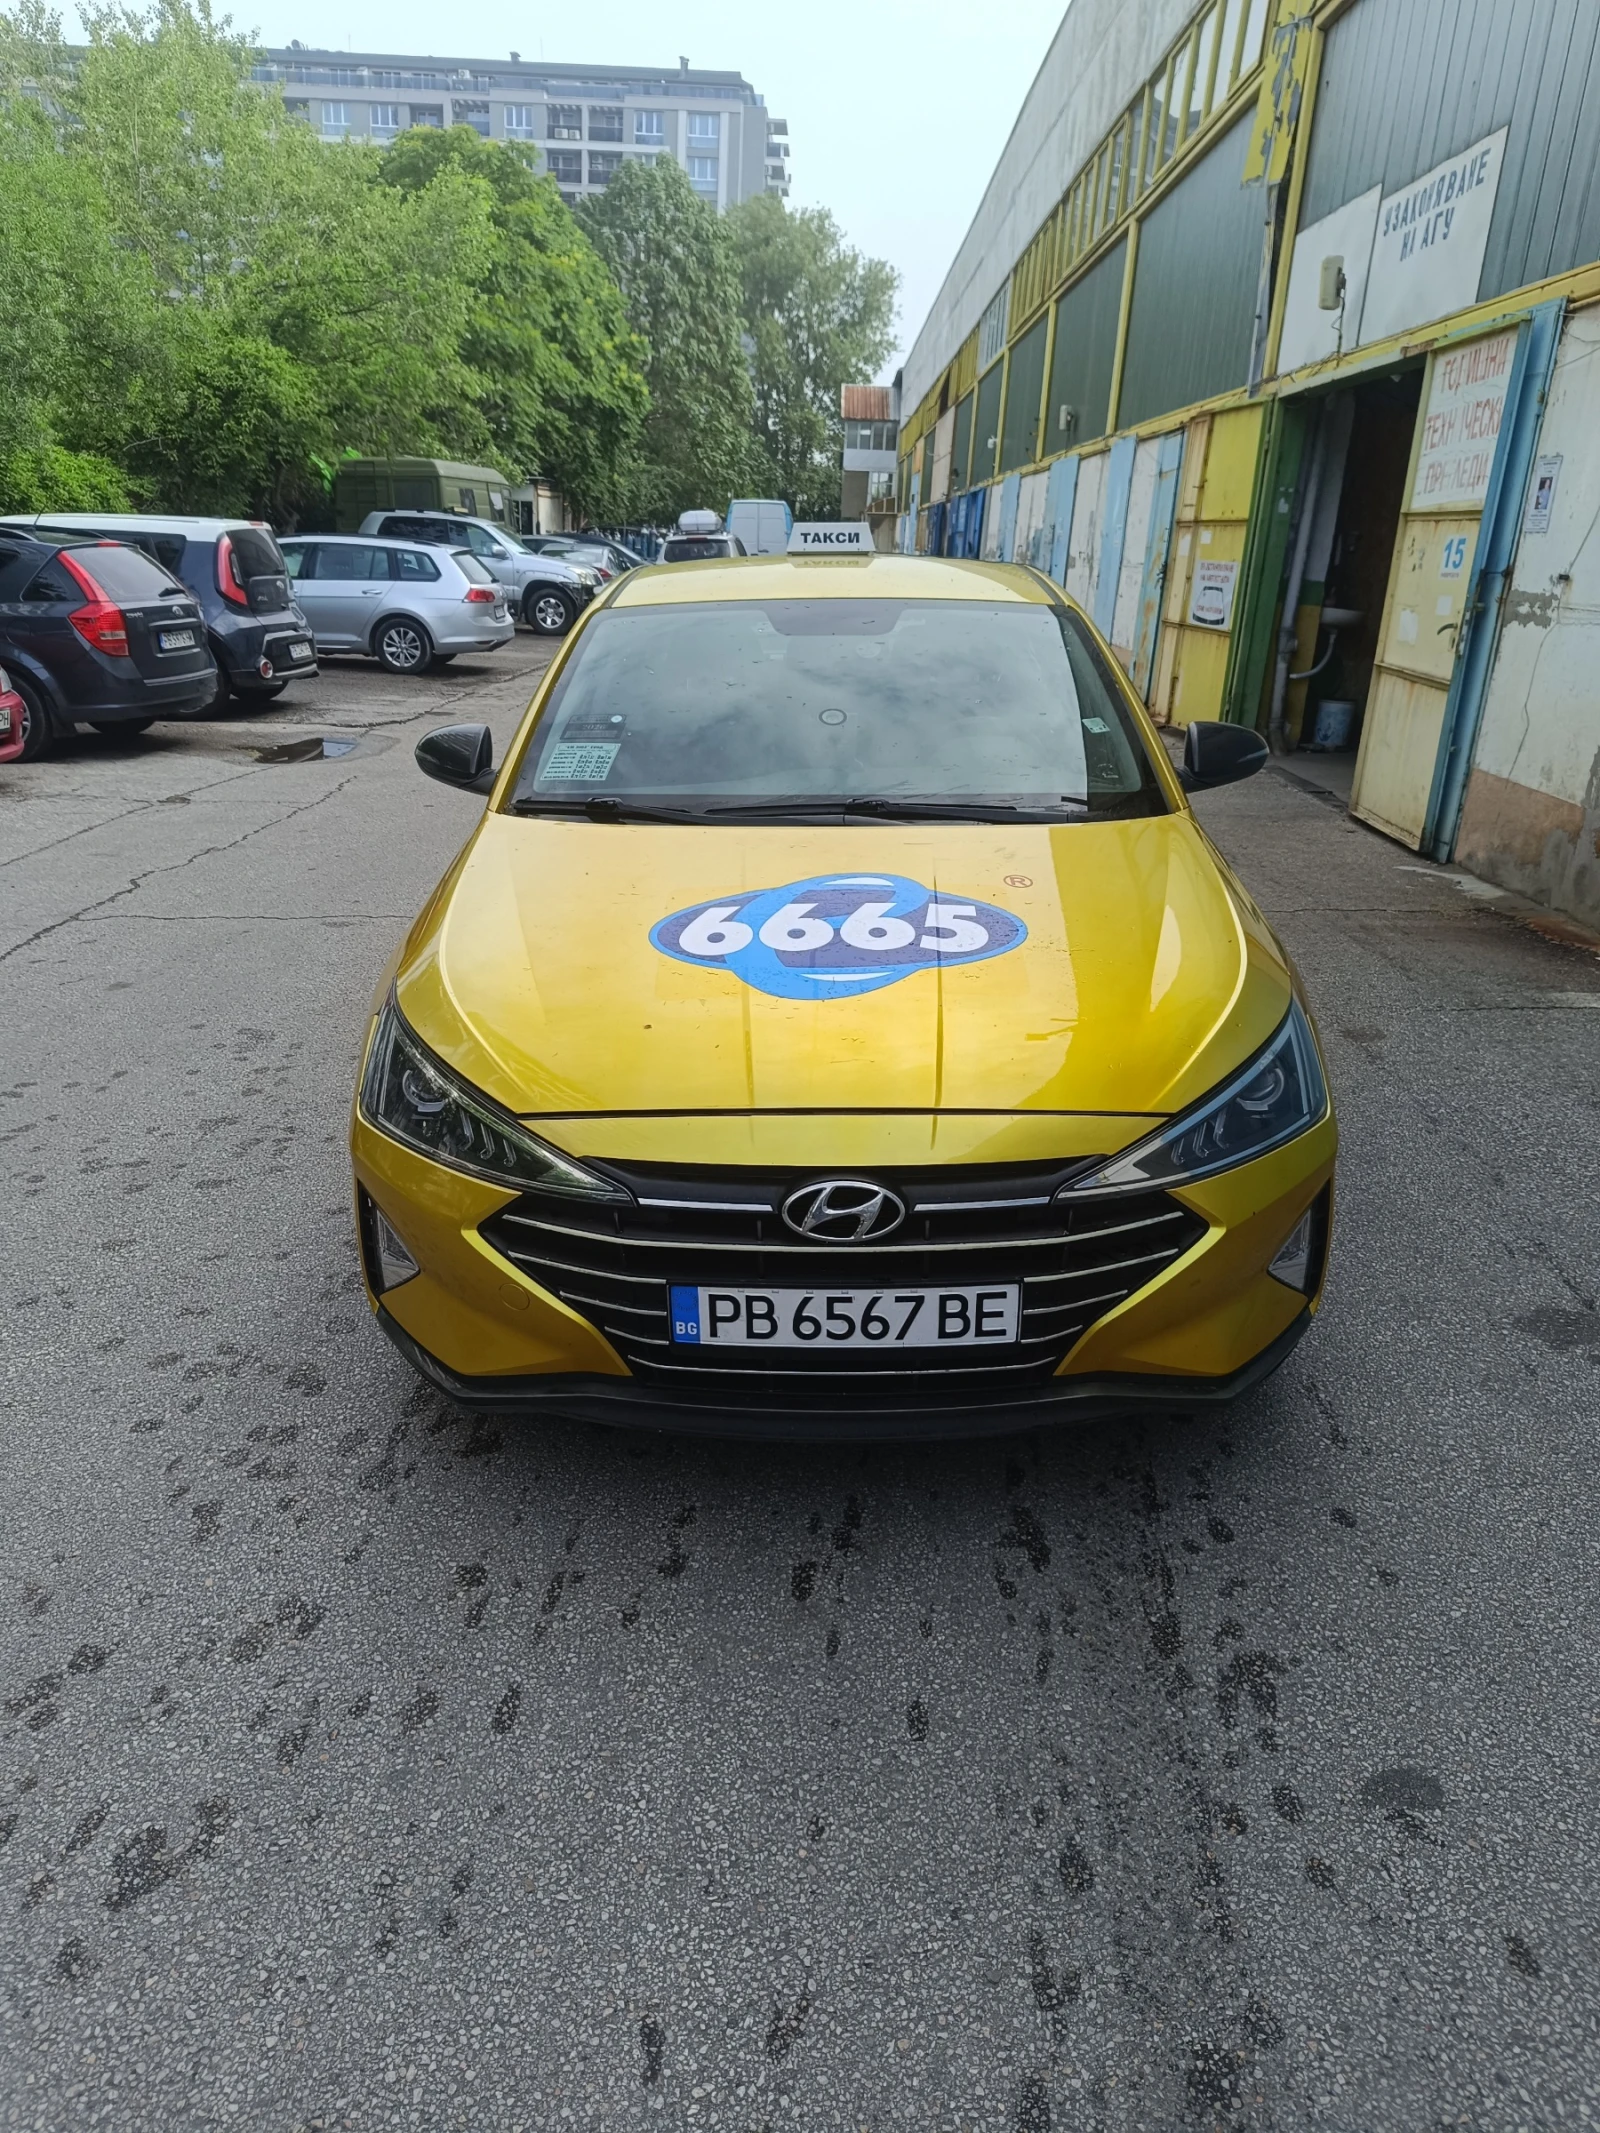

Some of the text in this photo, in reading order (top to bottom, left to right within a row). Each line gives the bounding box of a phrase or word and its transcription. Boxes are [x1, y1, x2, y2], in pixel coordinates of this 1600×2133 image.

[1420, 206, 1456, 250] АГУ
[800, 532, 860, 544] ТАКСИ
[1444, 537, 1467, 570] 15
[678, 902, 990, 956] 6665
[675, 1321, 698, 1335] BG
[707, 1290, 1008, 1341] PB 6567 BE
